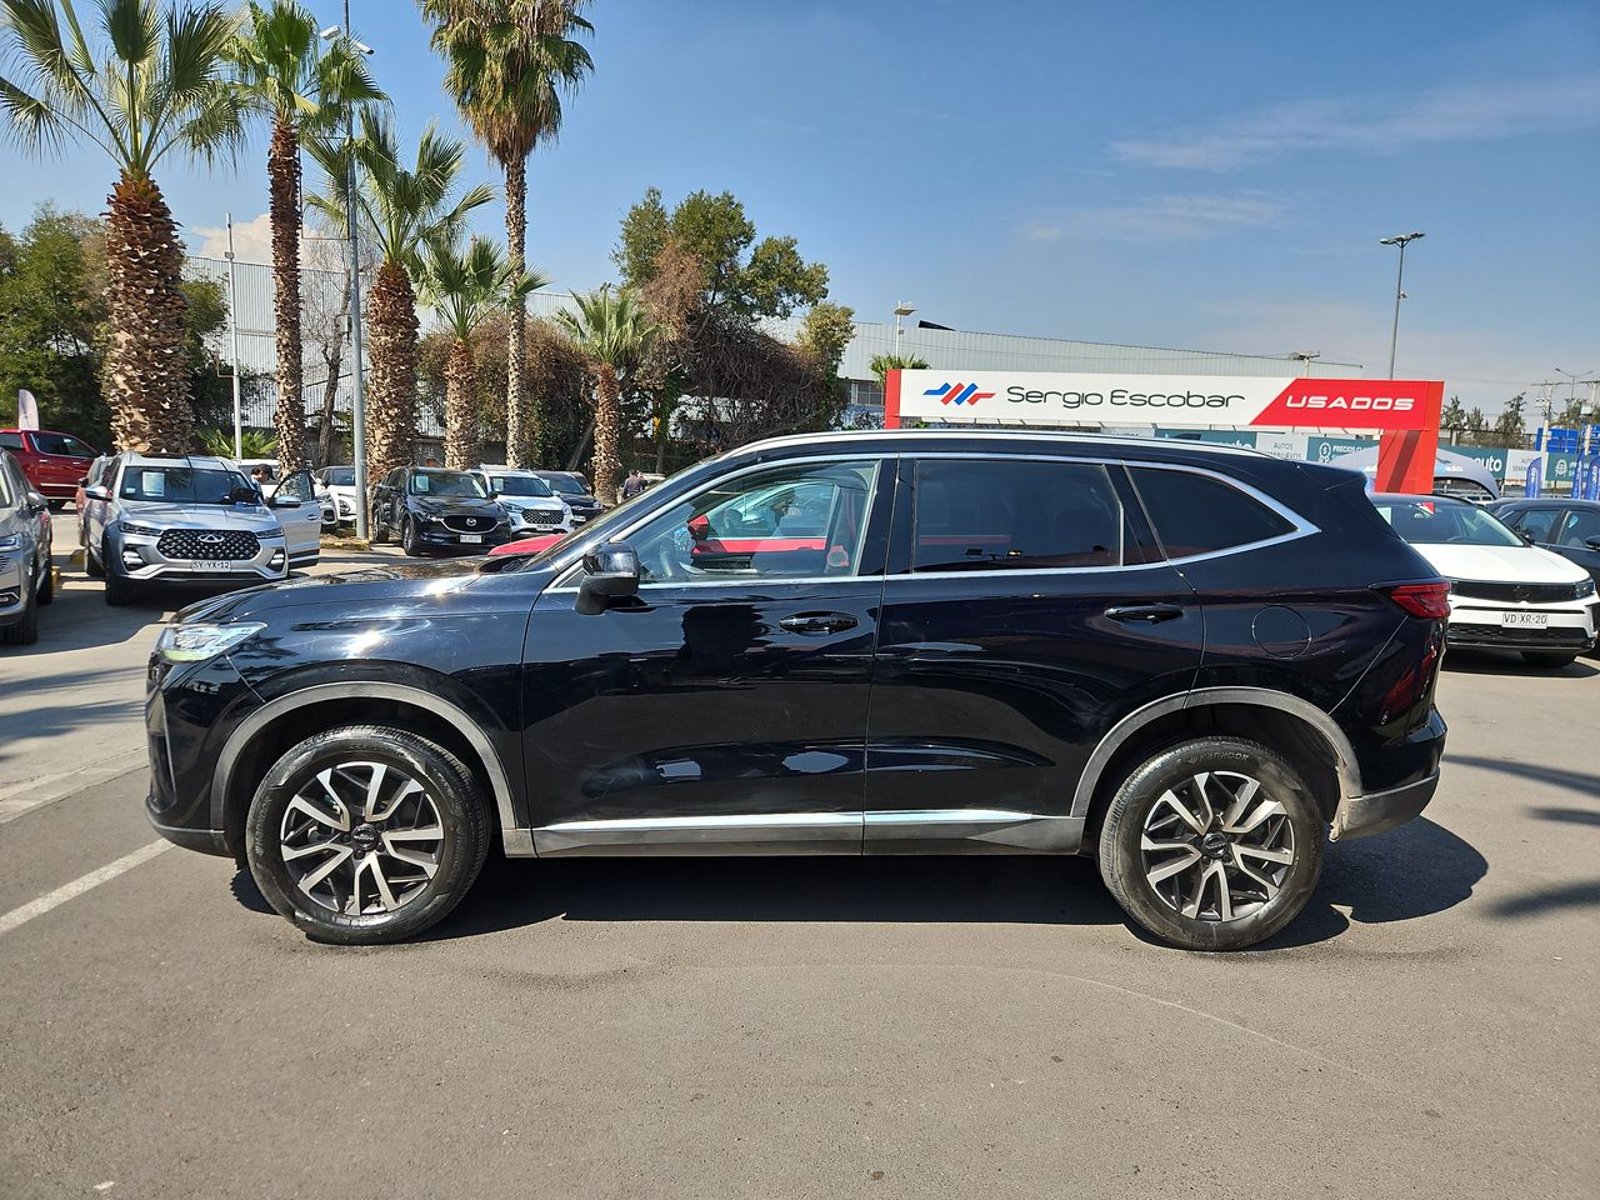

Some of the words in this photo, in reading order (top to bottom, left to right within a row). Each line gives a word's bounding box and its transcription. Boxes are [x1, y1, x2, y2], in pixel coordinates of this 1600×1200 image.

[1006, 386, 1103, 409] Sergio
[1110, 389, 1245, 408] Escobar
[1285, 395, 1415, 411] USADOS
[1504, 613, 1517, 623] VD
